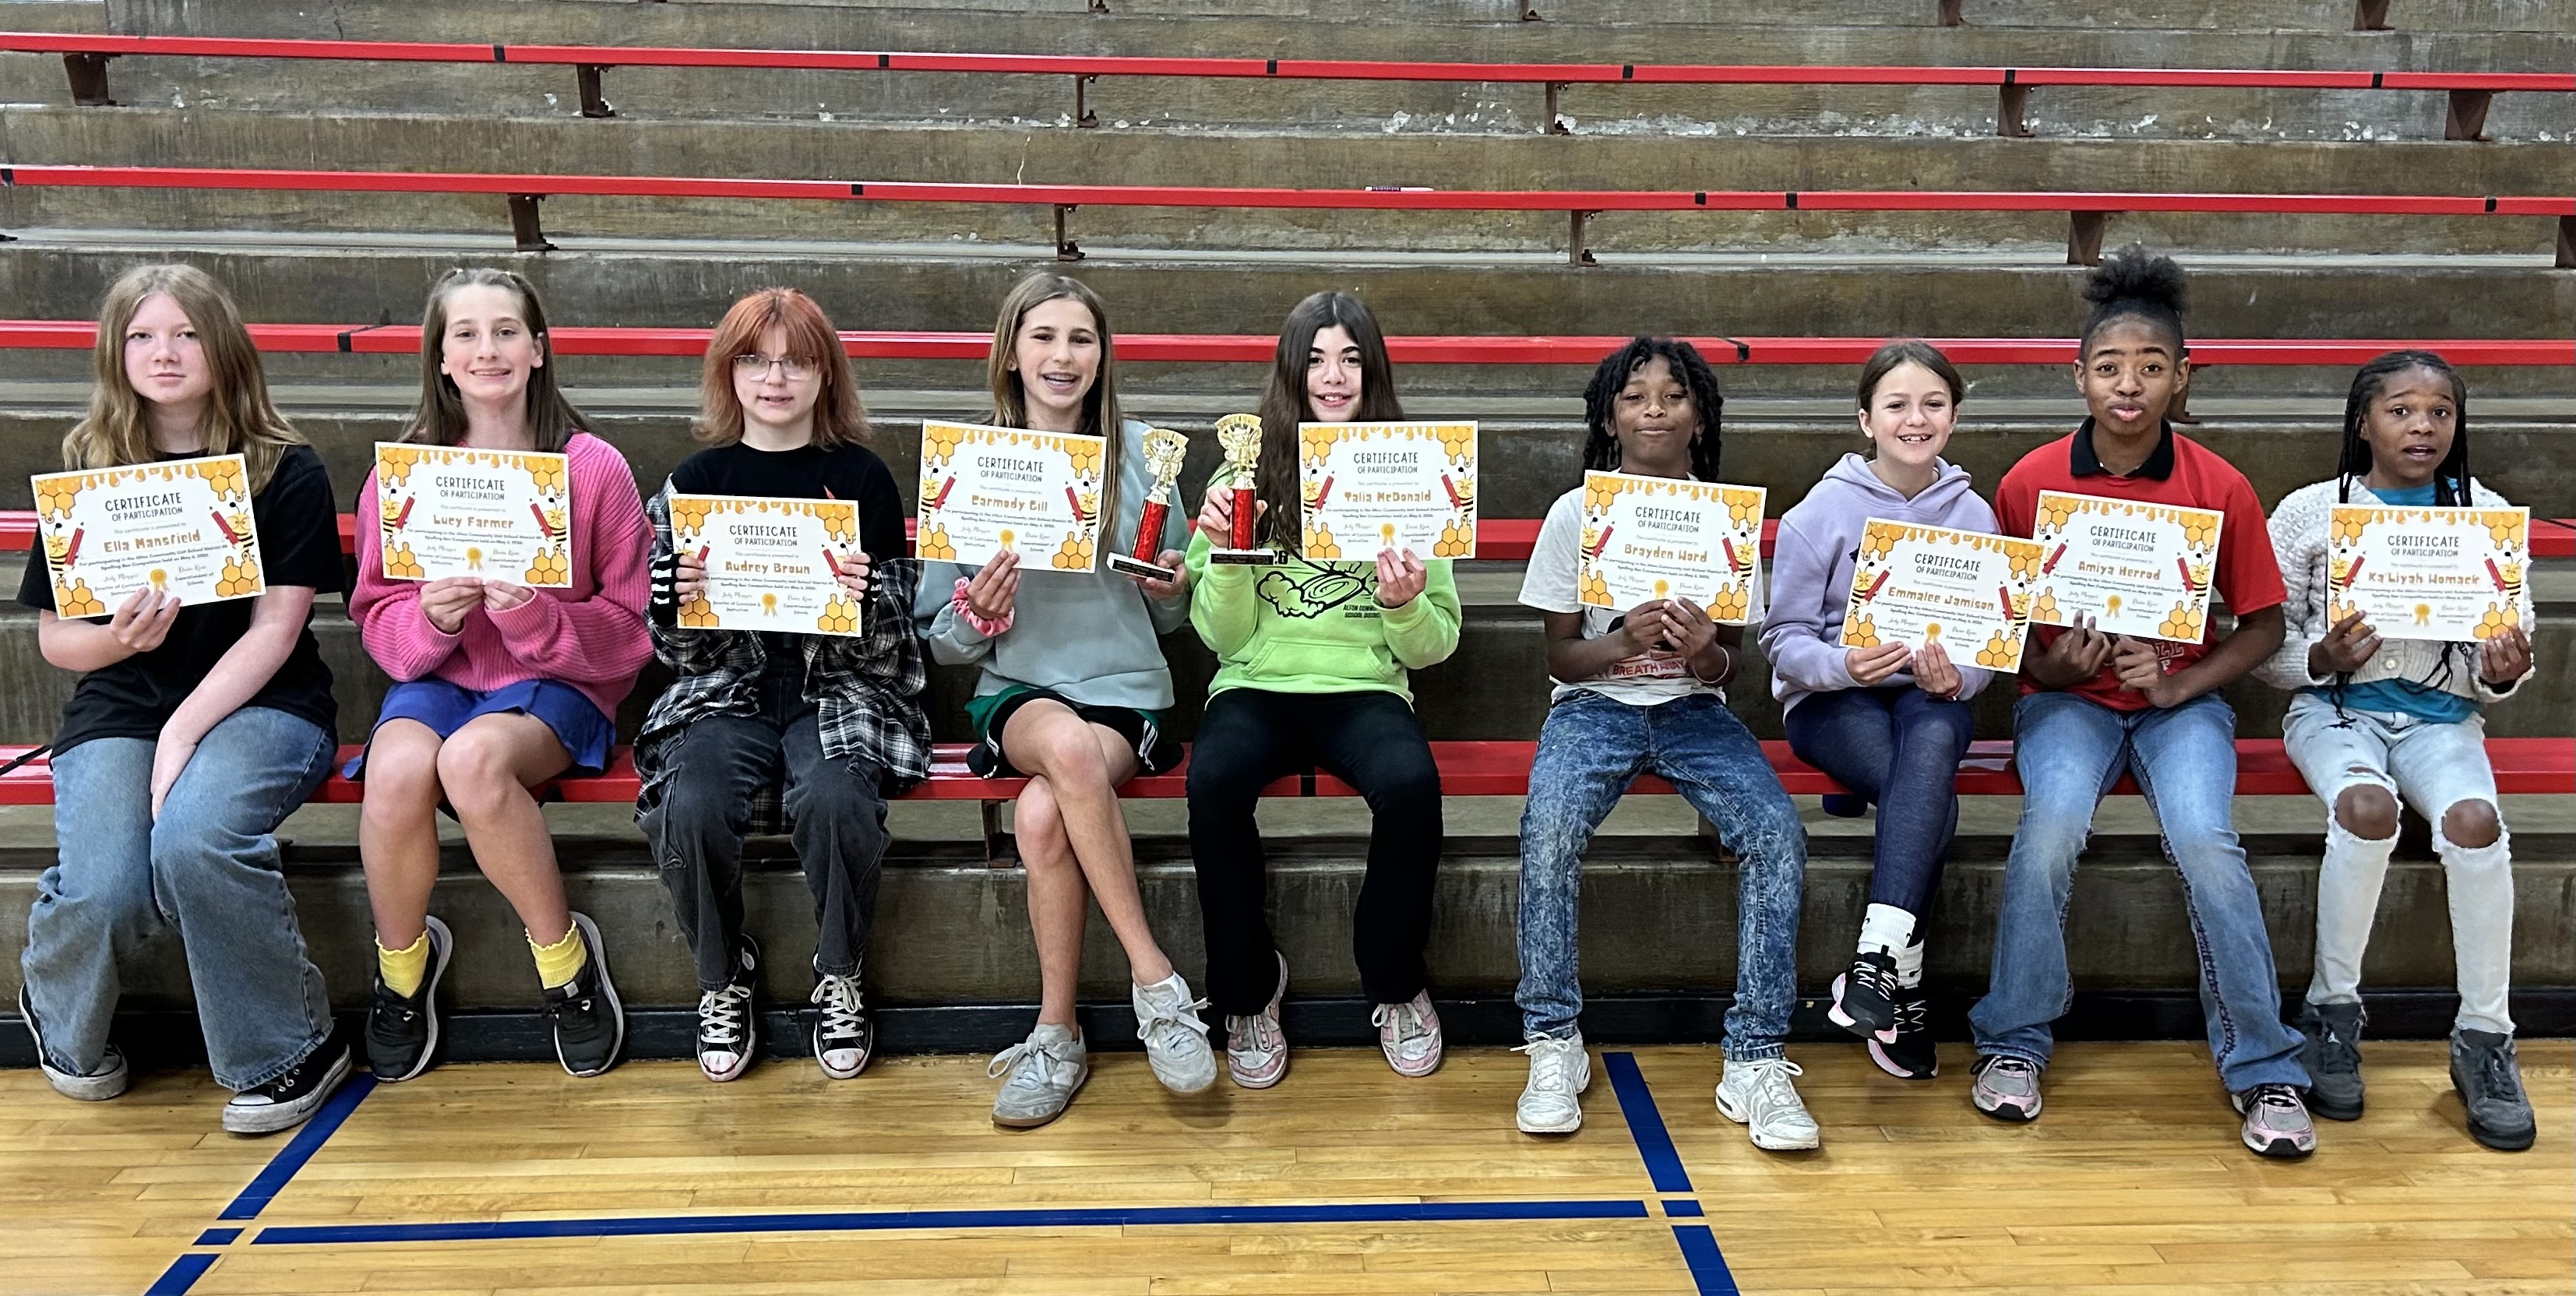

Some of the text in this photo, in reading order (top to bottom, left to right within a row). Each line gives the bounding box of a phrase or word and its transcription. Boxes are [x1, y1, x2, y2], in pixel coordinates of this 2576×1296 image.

[978, 456, 1043, 473] CERTIFICATE
[1353, 452, 1418, 464] CERTIFICATE
[991, 470, 1042, 482] PARTICIPATION
[1357, 466, 1418, 474] OF PARTICIPATION
[435, 476, 505, 491] CERTIFICATE
[439, 489, 505, 501] OF PARTICIPATION
[1344, 491, 1372, 502] Talia
[105, 492, 181, 512] CERTIFICATE
[111, 506, 183, 522] OF PARTICIPATION
[1635, 506, 1700, 523] CERTIFICATE
[467, 516, 514, 529] Farmer
[1637, 519, 1699, 533] OF PARTICIPATION
[729, 525, 797, 537] CERTIFICATE
[2090, 526, 2156, 544] CERTIFICATE
[104, 529, 200, 553] Ella Mansfield
[734, 537, 798, 547] OF PARTICIPATION
[2102, 539, 2154, 552] PARTICIPATION
[2387, 535, 2459, 548] CERTIFICATE
[1625, 544, 1673, 559] Brayden
[2391, 548, 2458, 557] OF PARTICIPATION
[725, 560, 768, 574] Audrey
[1915, 553, 1981, 572] CERTIFICATE
[1926, 567, 1978, 580] PARTICIPATION
[2078, 561, 2161, 580] Amiya Herrod
[1888, 586, 1994, 611] Emmalee Jamison
[1612, 664, 1658, 676] BREATH
